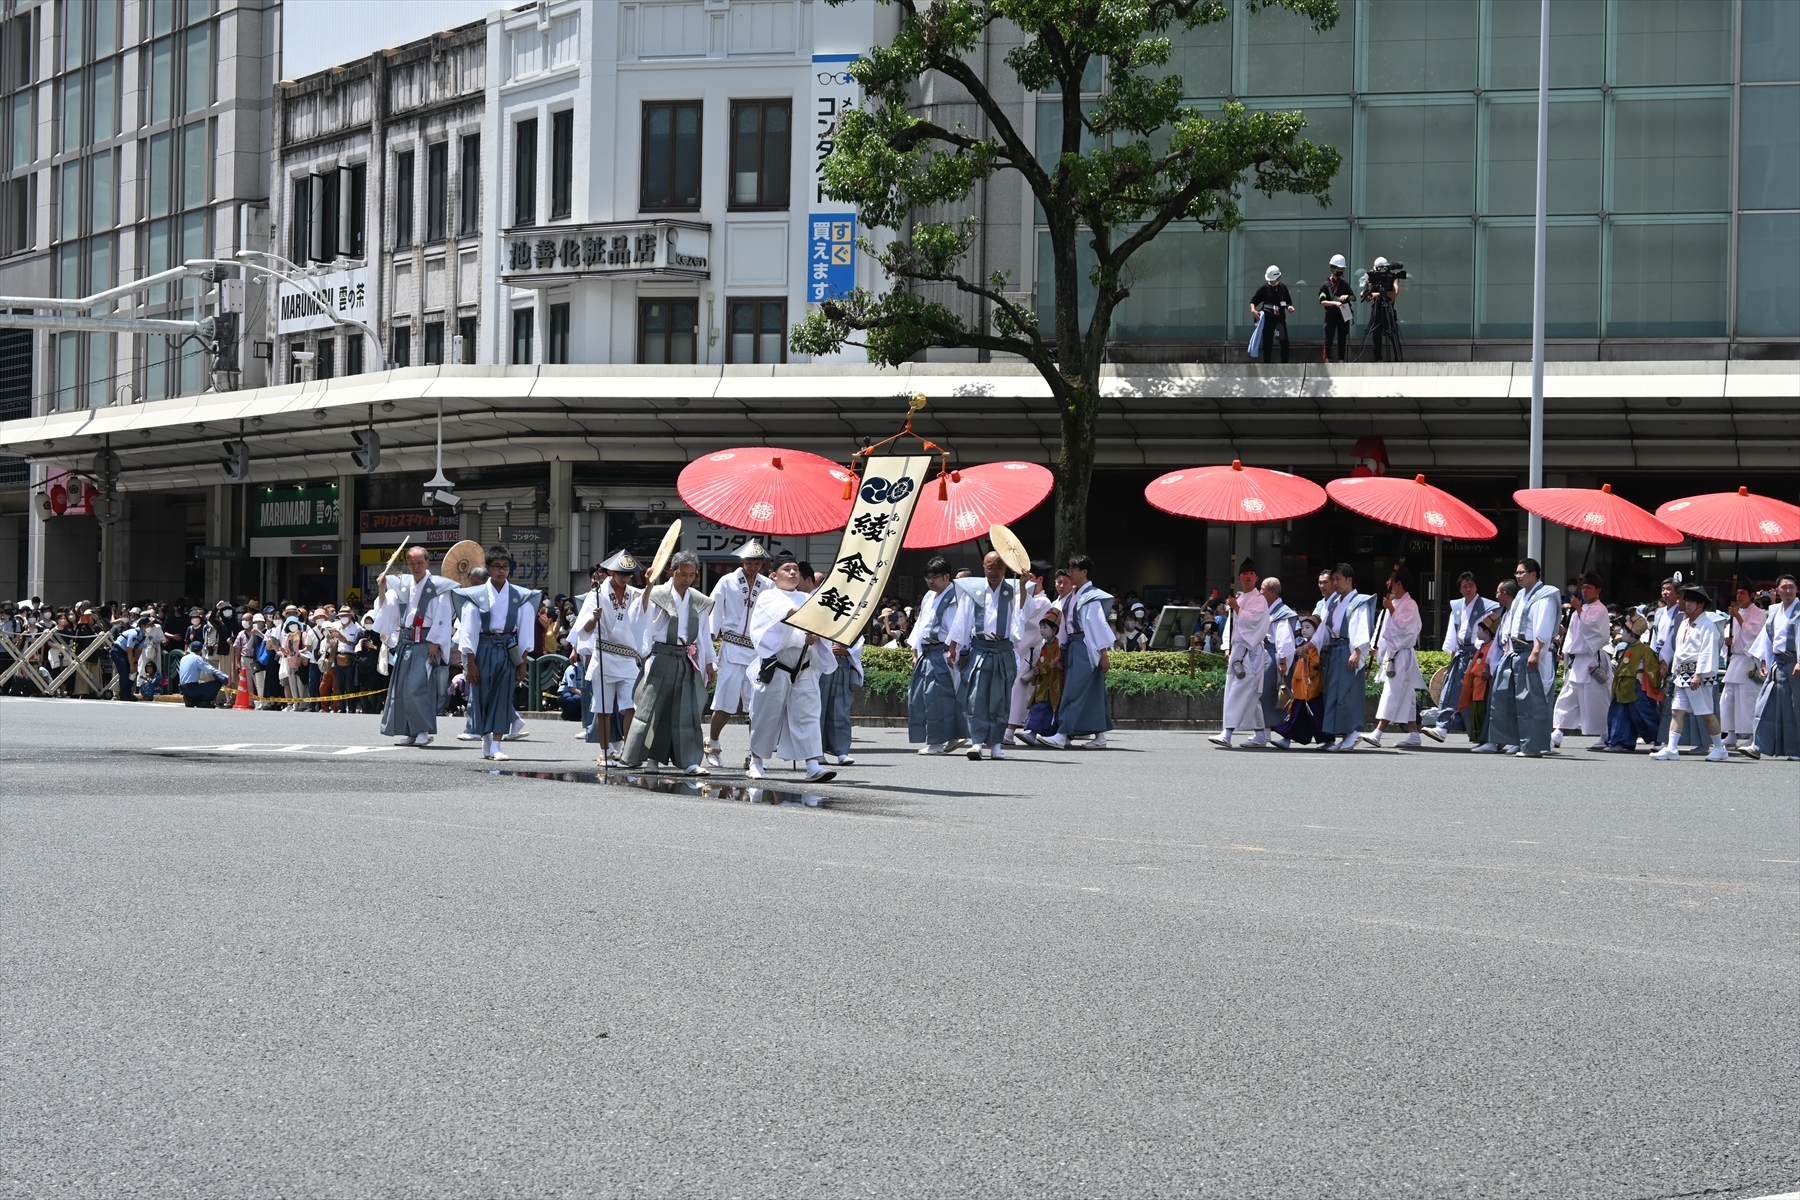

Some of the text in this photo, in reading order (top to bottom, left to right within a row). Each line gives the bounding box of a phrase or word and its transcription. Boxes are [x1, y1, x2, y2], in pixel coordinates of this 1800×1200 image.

[509, 233, 658, 271] 池善化粧品店
[834, 223, 851, 264] すぐ
[813, 222, 831, 300] 買えます
[339, 282, 365, 312] 雲の茶
[260, 500, 312, 527] MARUMARU
[373, 513, 439, 529] アクセスチケット
[427, 530, 459, 541] ACCESS TICKET
[1425, 541, 1491, 554] Taashimaya
[817, 512, 890, 622] 綾傘鉾
